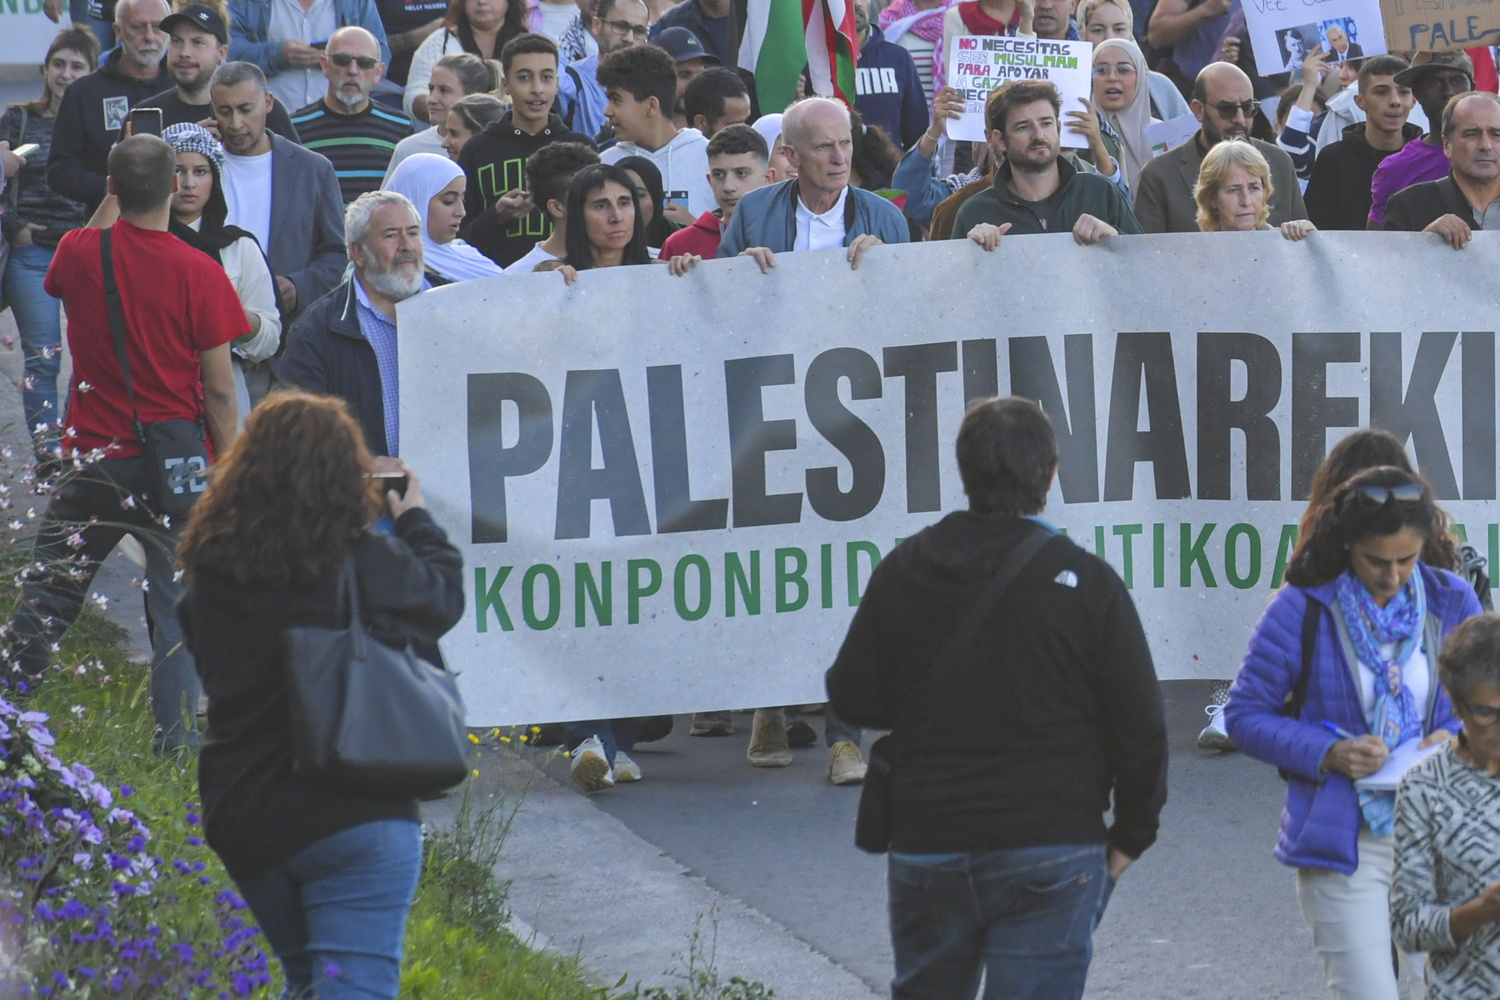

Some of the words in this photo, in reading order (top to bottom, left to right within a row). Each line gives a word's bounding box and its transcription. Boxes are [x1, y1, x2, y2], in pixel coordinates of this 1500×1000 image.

[958, 38, 978, 50] NO
[957, 51, 989, 64] SER
[994, 53, 1078, 70] MUSULMAN
[957, 63, 991, 77] PARA
[997, 66, 1049, 80] APOYAR
[955, 75, 968, 88] A
[474, 535, 907, 634] KONPONBID
